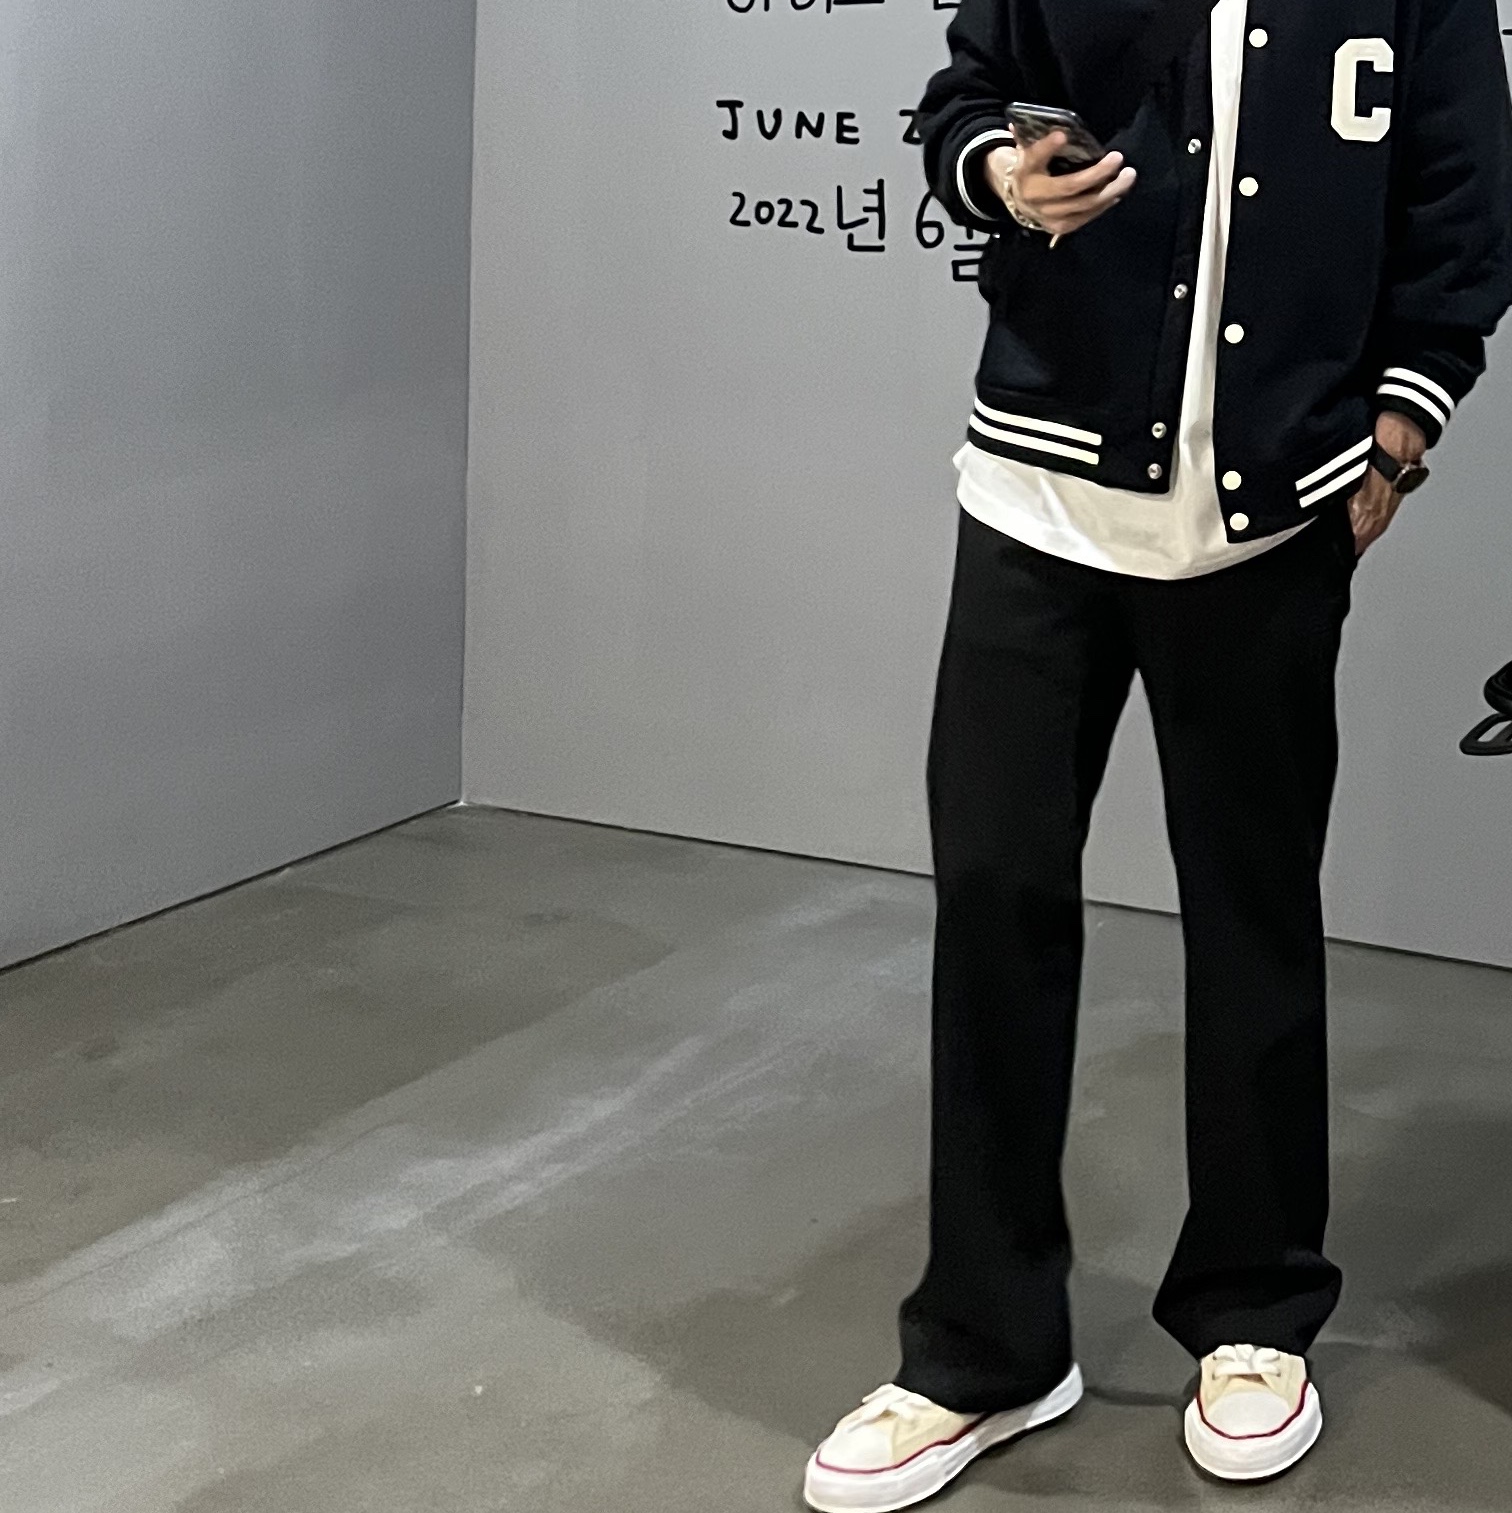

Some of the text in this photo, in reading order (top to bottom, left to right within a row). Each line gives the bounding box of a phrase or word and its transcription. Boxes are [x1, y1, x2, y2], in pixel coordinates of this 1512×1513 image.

[715, 99, 861, 145] JUNE
[1330, 37, 1395, 143] C
[728, 178, 887, 253] 2022년
